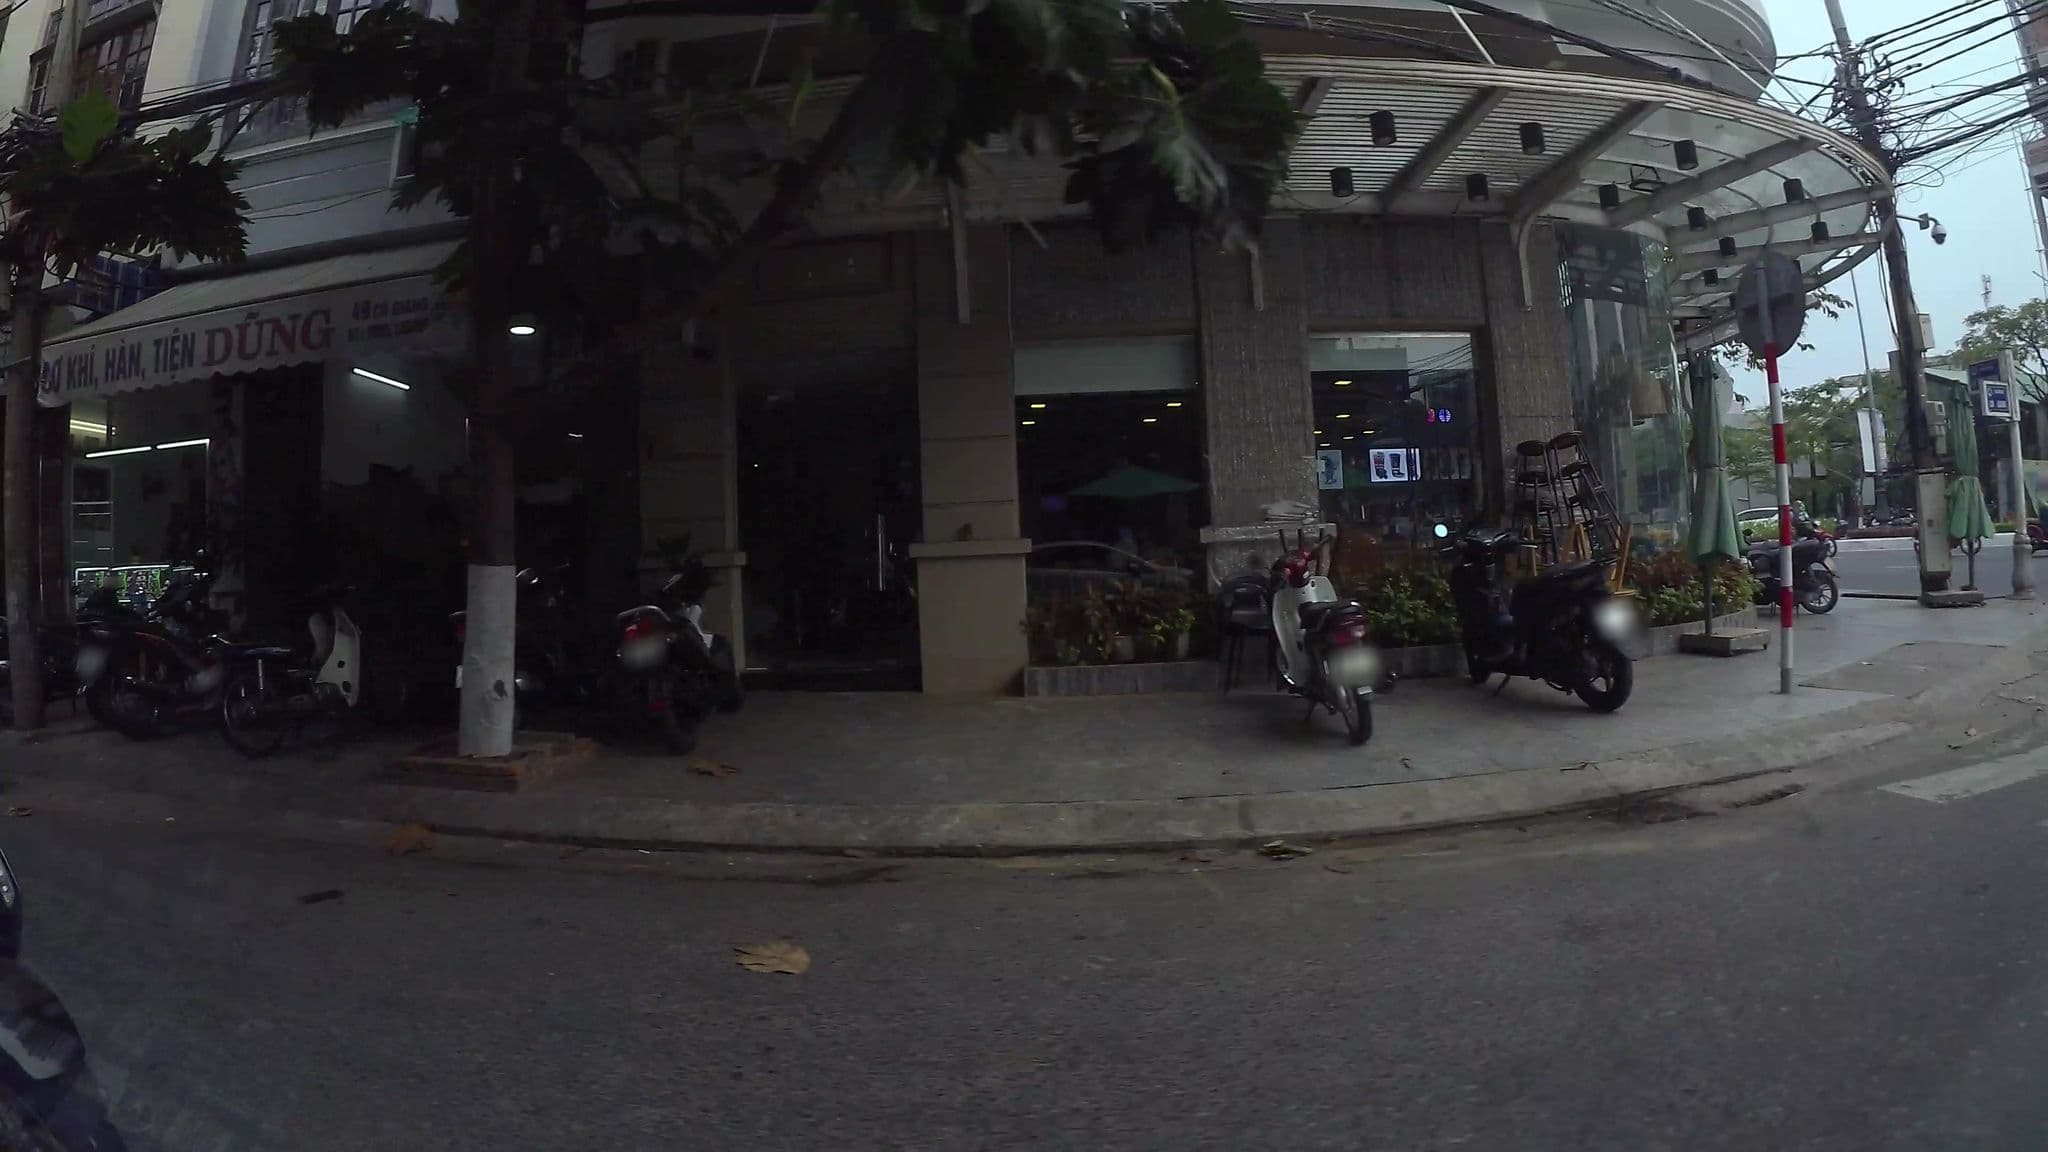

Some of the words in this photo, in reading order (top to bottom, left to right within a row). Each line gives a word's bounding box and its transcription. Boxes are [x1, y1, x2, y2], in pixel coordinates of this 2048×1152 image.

[66, 343, 98, 390] KHÍ,
[105, 338, 145, 382] HÀN,
[154, 328, 196, 379] TIỆN
[203, 309, 336, 366] DŨNG
